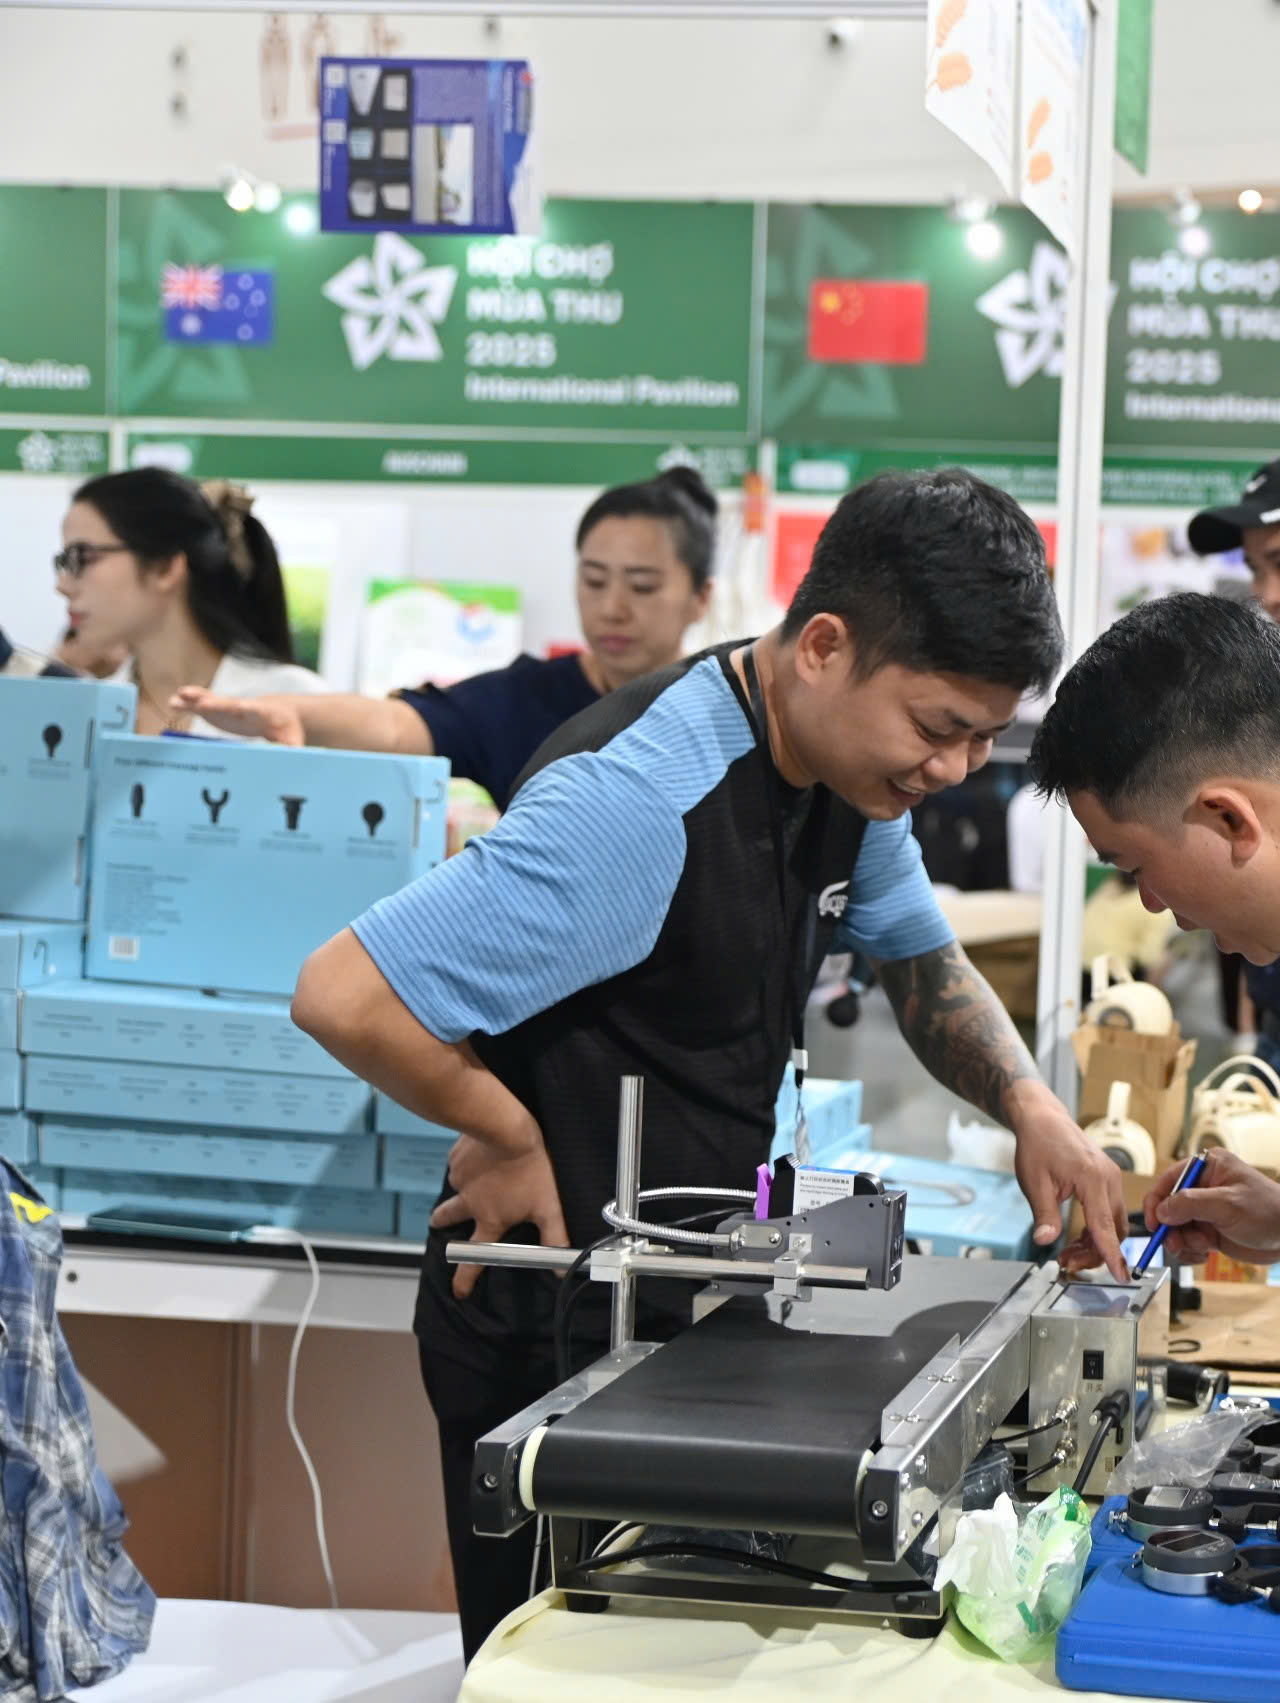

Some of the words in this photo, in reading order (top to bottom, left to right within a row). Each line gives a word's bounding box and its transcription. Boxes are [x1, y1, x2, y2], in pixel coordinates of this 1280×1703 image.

[551, 288, 623, 323] THU
[466, 332, 556, 367] 2025
[1127, 350, 1221, 385] 2025
[465, 373, 630, 403] International
[634, 376, 740, 406] Pavilion
